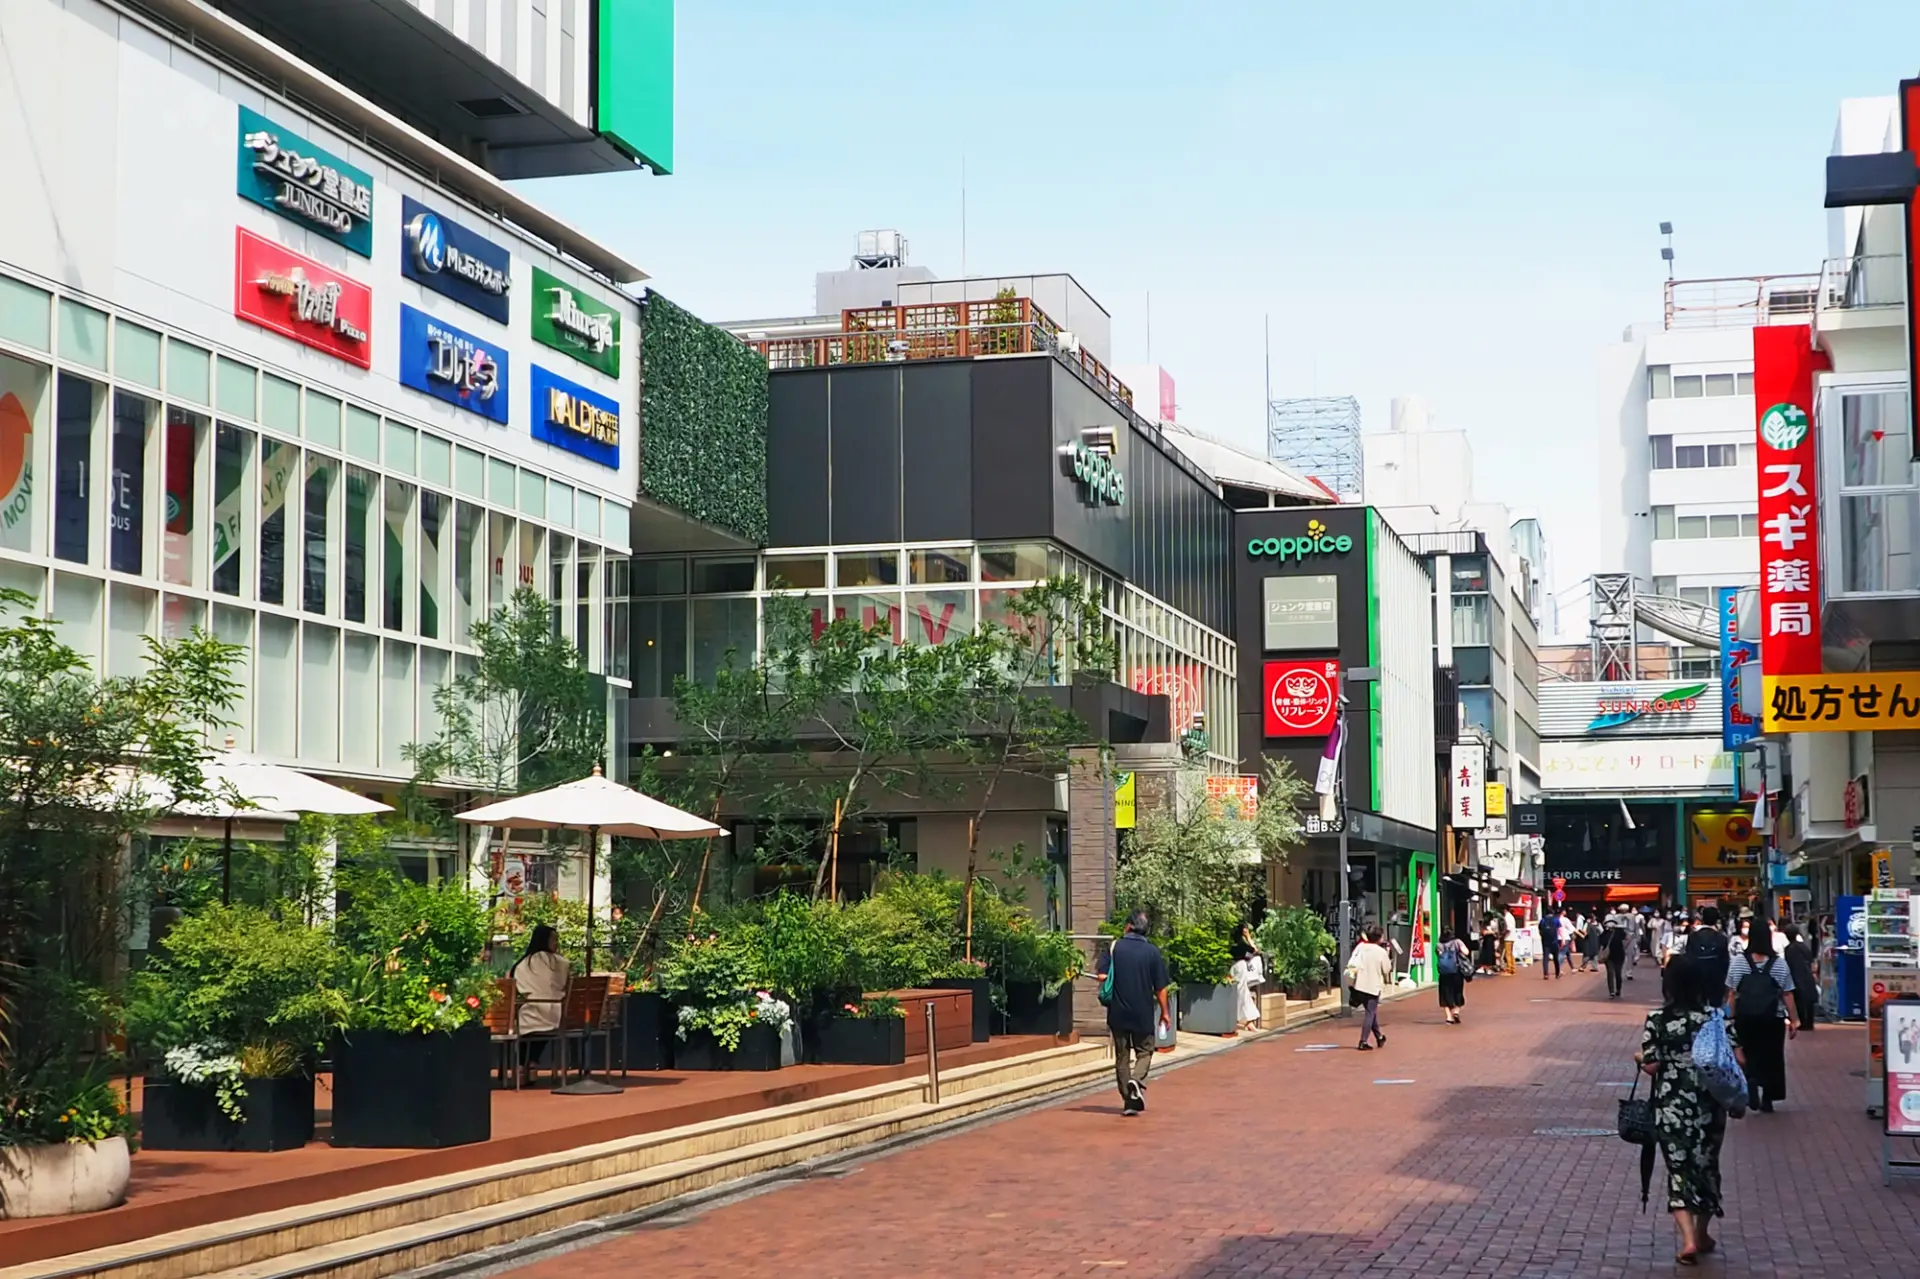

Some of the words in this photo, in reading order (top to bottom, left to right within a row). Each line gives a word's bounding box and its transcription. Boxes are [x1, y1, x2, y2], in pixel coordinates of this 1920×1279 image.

[276, 182, 352, 234] JUNKUDO
[550, 387, 596, 438] KALDI
[1247, 533, 1353, 562] coppice
[1762, 464, 1812, 636] スギ薬局
[811, 602, 956, 649] HMV
[1281, 706, 1325, 717] リフレーヌ
[1598, 698, 1696, 714] SUNROAD
[1772, 684, 1920, 721] 処方せん
[1584, 868, 1622, 880] CAFFÉ
